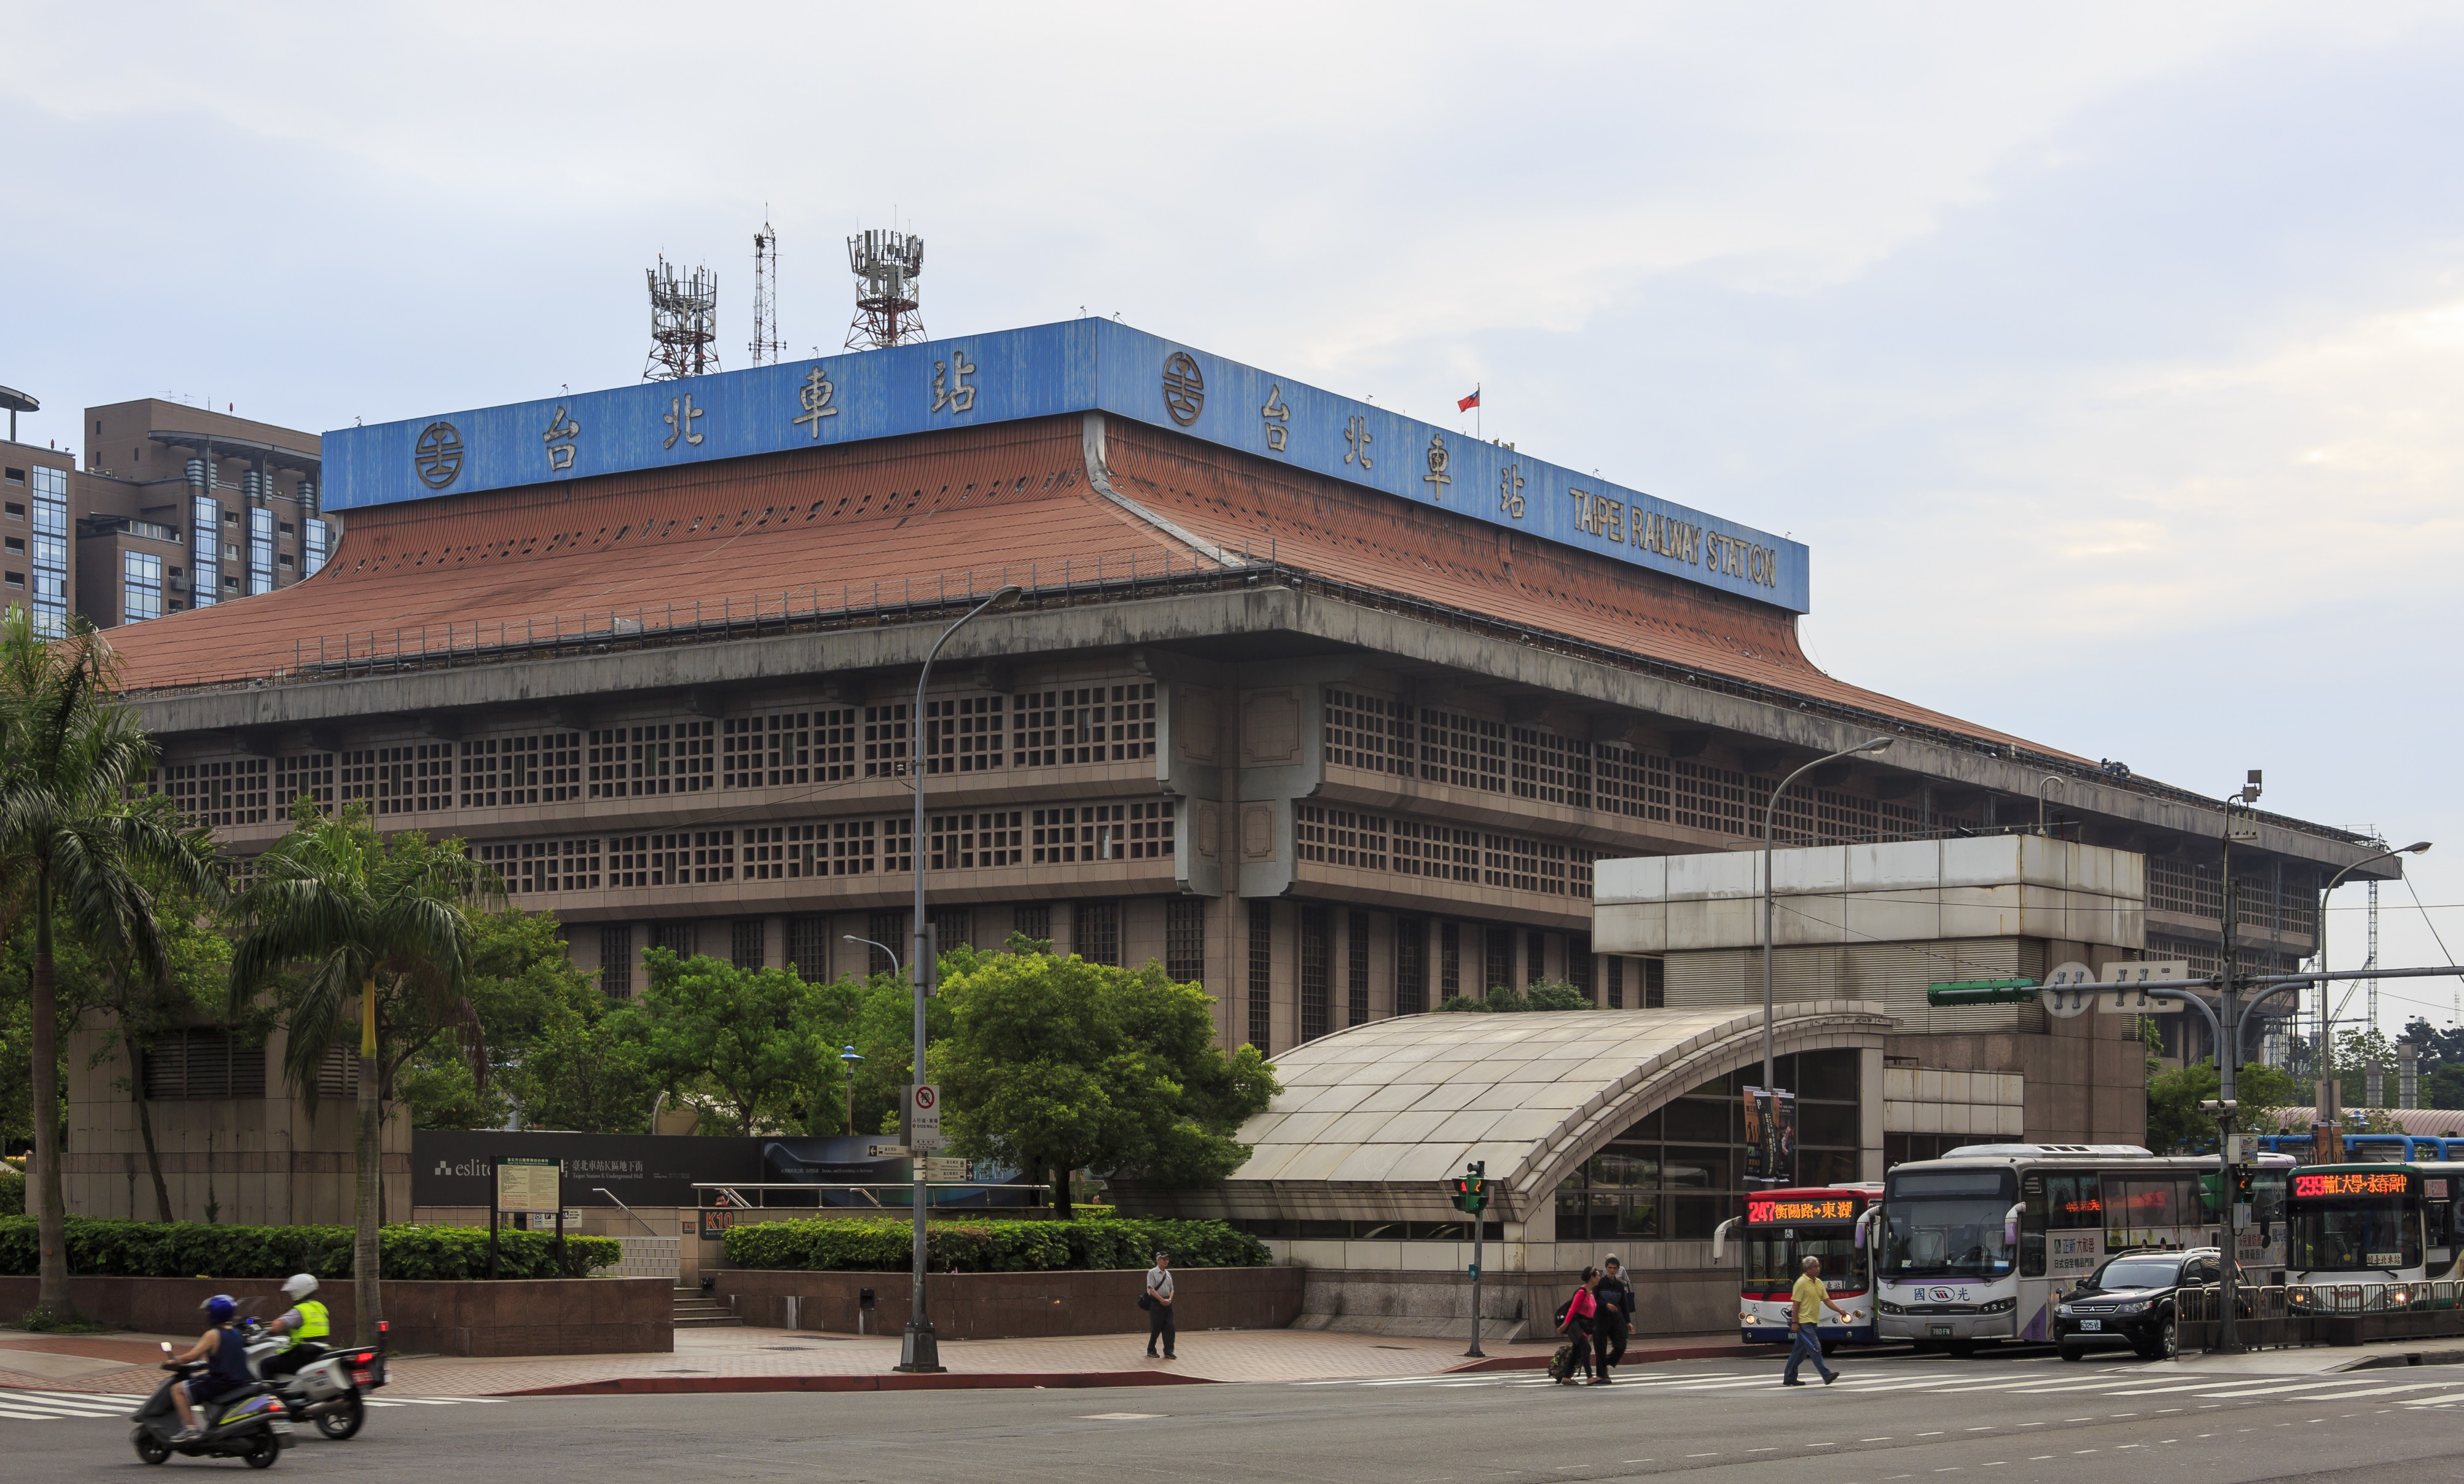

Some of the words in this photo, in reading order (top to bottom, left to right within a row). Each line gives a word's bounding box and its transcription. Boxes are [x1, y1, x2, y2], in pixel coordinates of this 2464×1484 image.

[543, 351, 976, 471] 台北車站
[1262, 383, 1526, 519] 台北車站
[1570, 487, 1624, 543] TAIPEI
[1631, 505, 1702, 566] RAILWAY
[1706, 531, 1776, 588] STATION
[2296, 1175, 2324, 1196] 299
[2323, 1175, 2362, 1194] 輔仁大學
[2367, 1174, 2407, 1193] 永春高中
[706, 1212, 733, 1229] K10
[1748, 1201, 1775, 1222] 247
[1775, 1203, 1814, 1219] 衡陽路
[1821, 1201, 1852, 1218] 東湖
[1914, 1287, 1925, 1301] 國
[1958, 1287, 1970, 1301] 光
